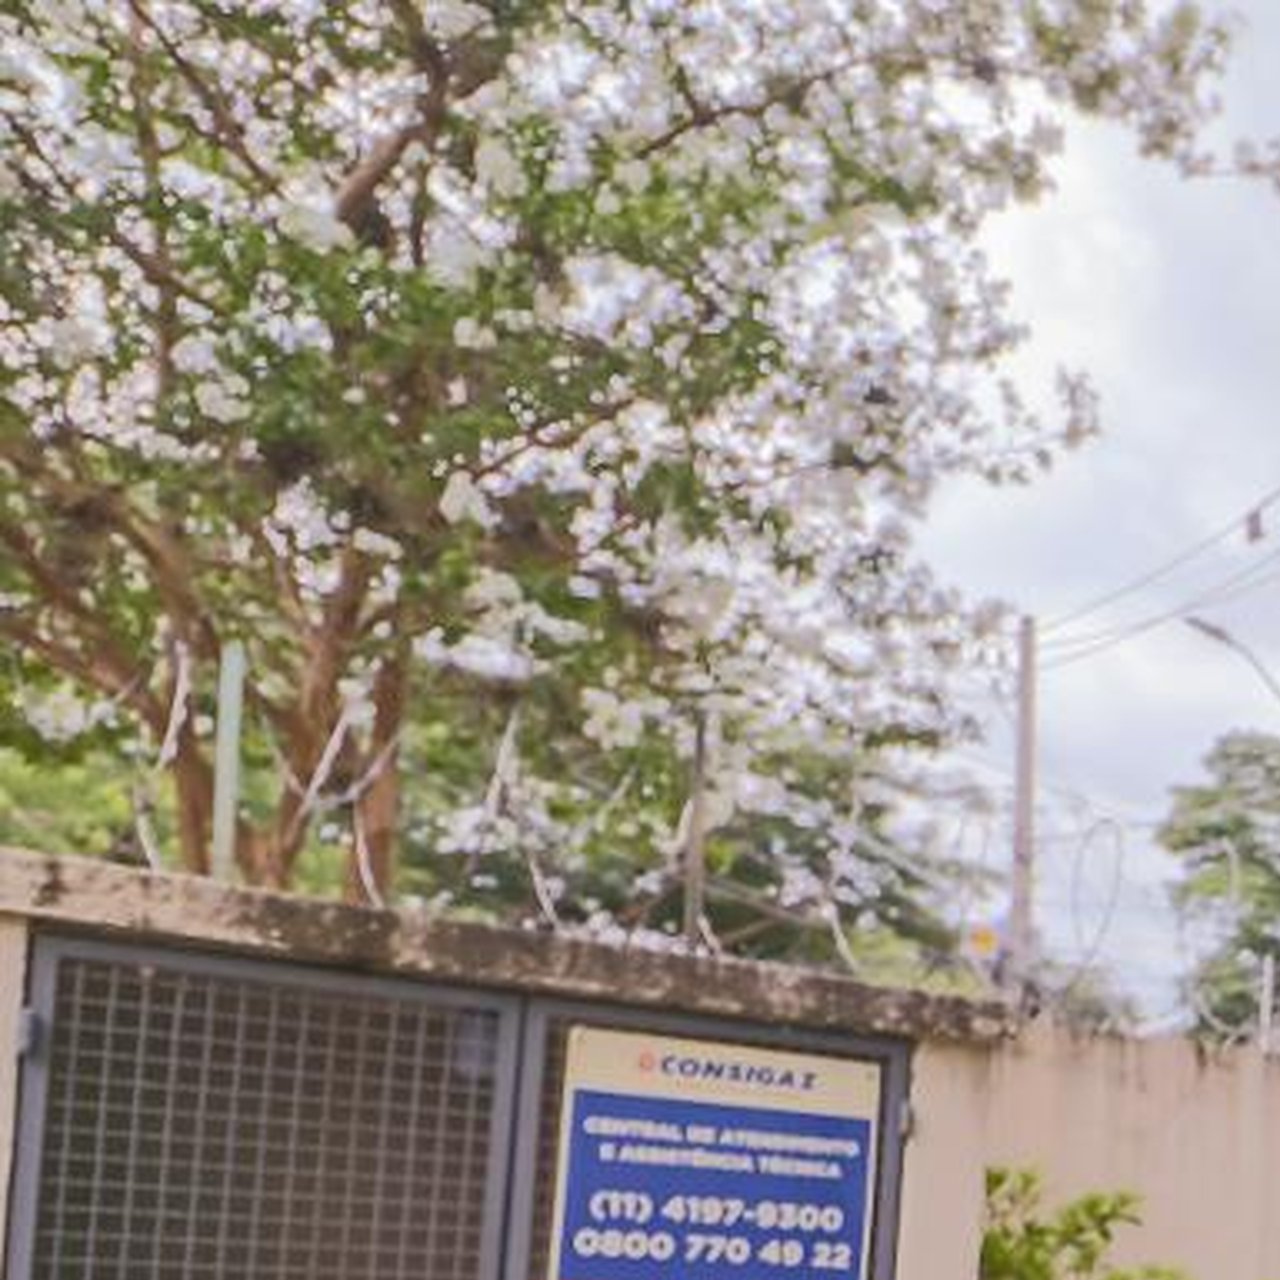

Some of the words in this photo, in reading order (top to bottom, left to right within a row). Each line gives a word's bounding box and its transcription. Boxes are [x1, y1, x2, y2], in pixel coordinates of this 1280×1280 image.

[589, 1190, 653, 1224] (11)
[573, 1227, 675, 1259] 0800
[684, 1233, 750, 1265] 770
[758, 1239, 803, 1267] 49
[811, 1242, 852, 1270] 22
